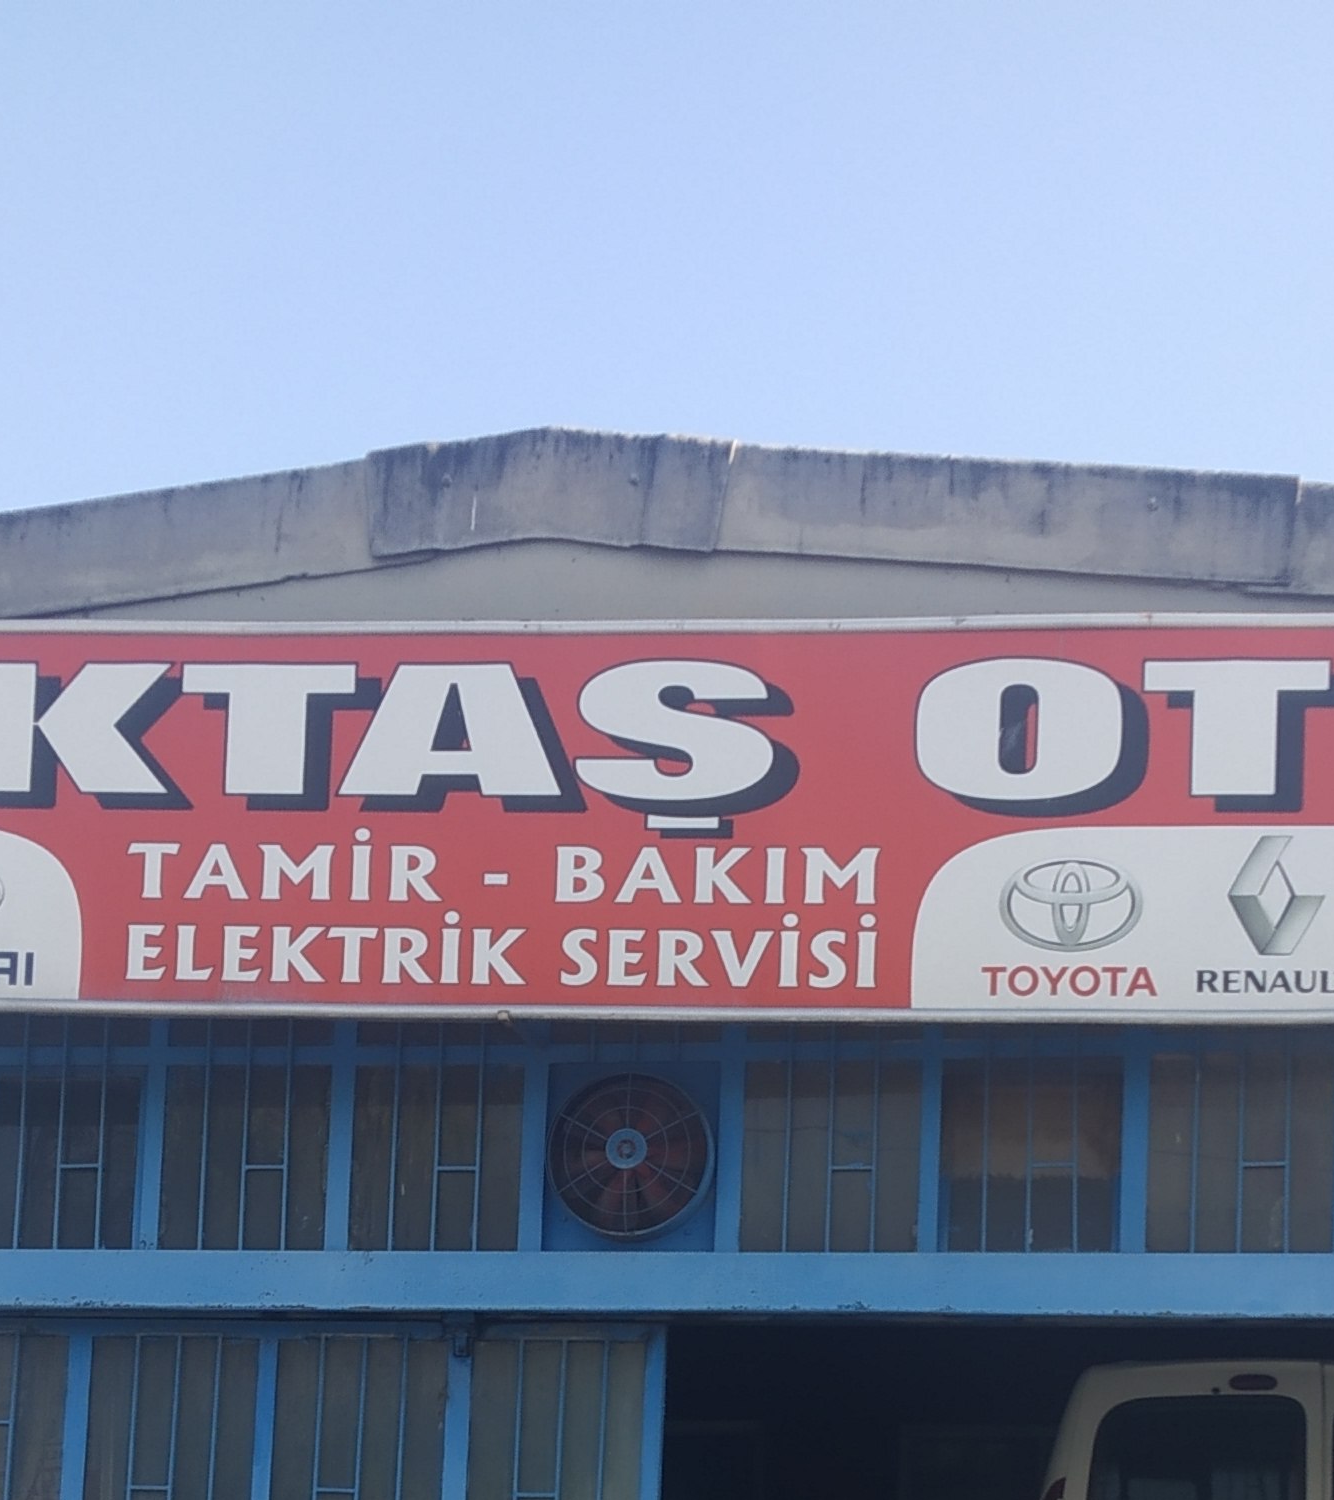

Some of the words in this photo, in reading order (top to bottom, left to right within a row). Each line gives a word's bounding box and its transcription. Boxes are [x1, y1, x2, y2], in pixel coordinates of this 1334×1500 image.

[126, 827, 442, 904] TAMİR
[554, 845, 881, 906] BAKIM
[124, 910, 529, 987] ELEKTRİK
[558, 912, 880, 990] SERVİSİ
[981, 965, 1158, 998] TOYOTA
